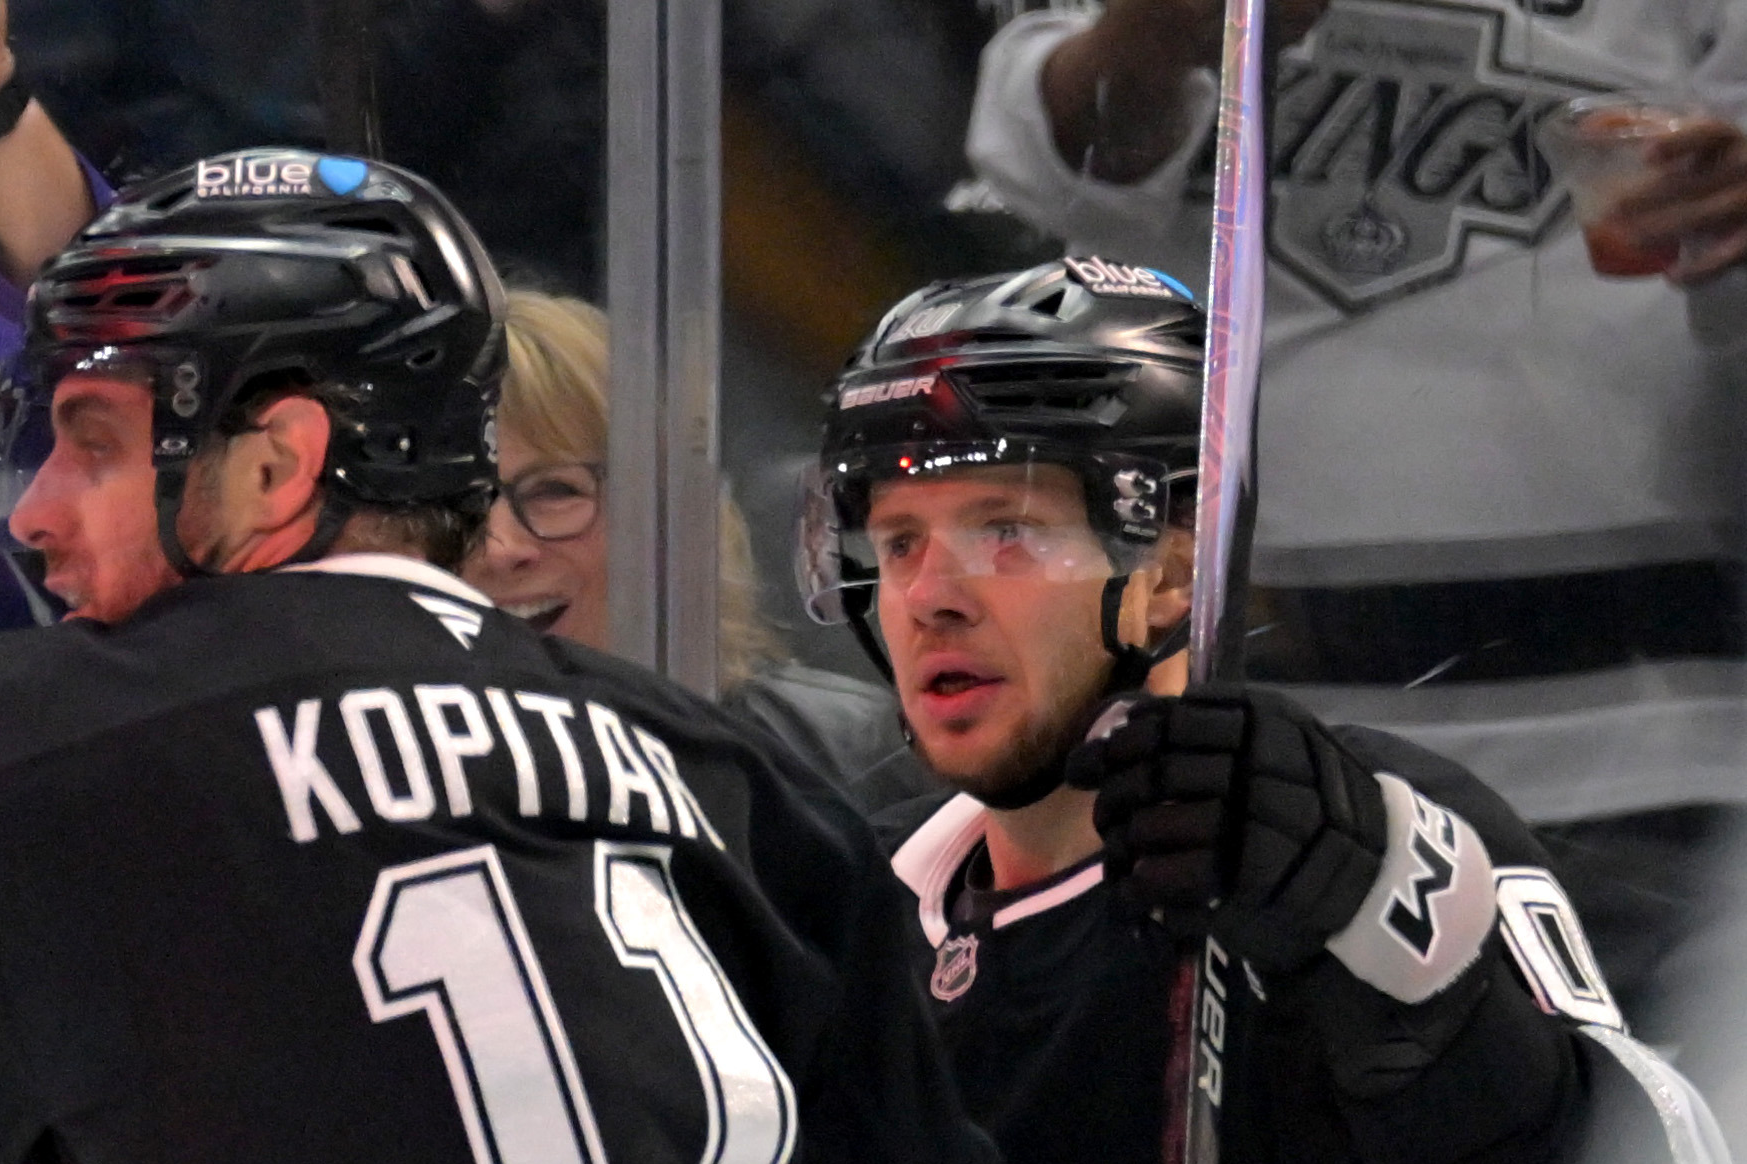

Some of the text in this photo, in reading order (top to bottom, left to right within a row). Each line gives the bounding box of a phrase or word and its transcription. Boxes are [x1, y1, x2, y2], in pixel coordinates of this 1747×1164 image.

[197, 158, 311, 187] blue
[1274, 64, 1576, 208] INGS
[1064, 255, 1162, 287] blue
[254, 684, 727, 851] KOPITAR
[1198, 934, 1229, 1107] UER
[1495, 866, 1628, 1036] 0
